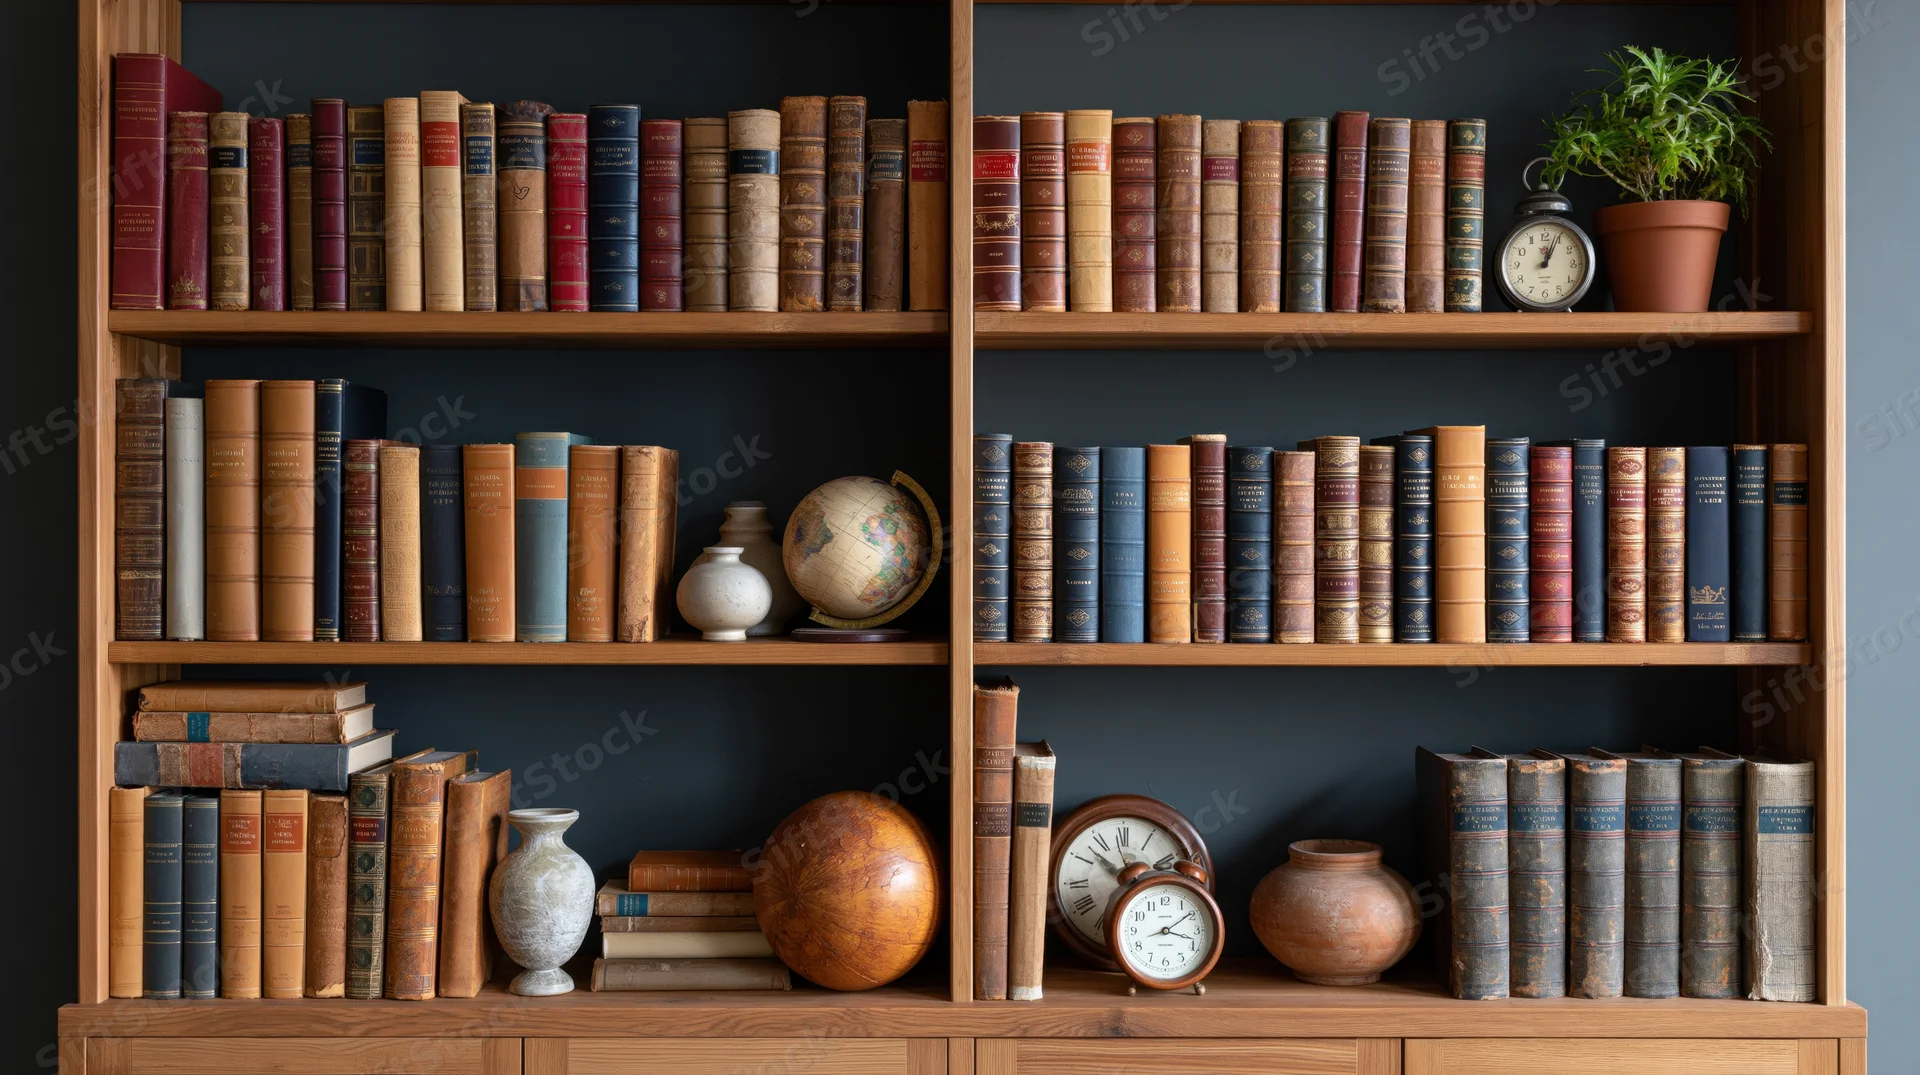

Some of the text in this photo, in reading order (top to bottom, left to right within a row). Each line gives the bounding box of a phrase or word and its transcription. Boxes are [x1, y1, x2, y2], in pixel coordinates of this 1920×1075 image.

[1513, 261, 1520, 270] 9
[1517, 275, 1524, 284] 8
[1528, 286, 1535, 294] 7
[1541, 289, 1548, 299] 6
[1147, 901, 1155, 911] 11
[1160, 896, 1170, 906] 12
[1179, 900, 1184, 910] 1
[1135, 911, 1145, 921] 10
[1188, 910, 1196, 920] 2
[1130, 927, 1137, 935] 9
[1193, 925, 1200, 935] 3
[1135, 941, 1142, 951] 8
[1188, 940, 1196, 951] 4
[1147, 953, 1153, 962] 7
[1162, 957, 1169, 967] 6
[1178, 952, 1184, 962] 5
